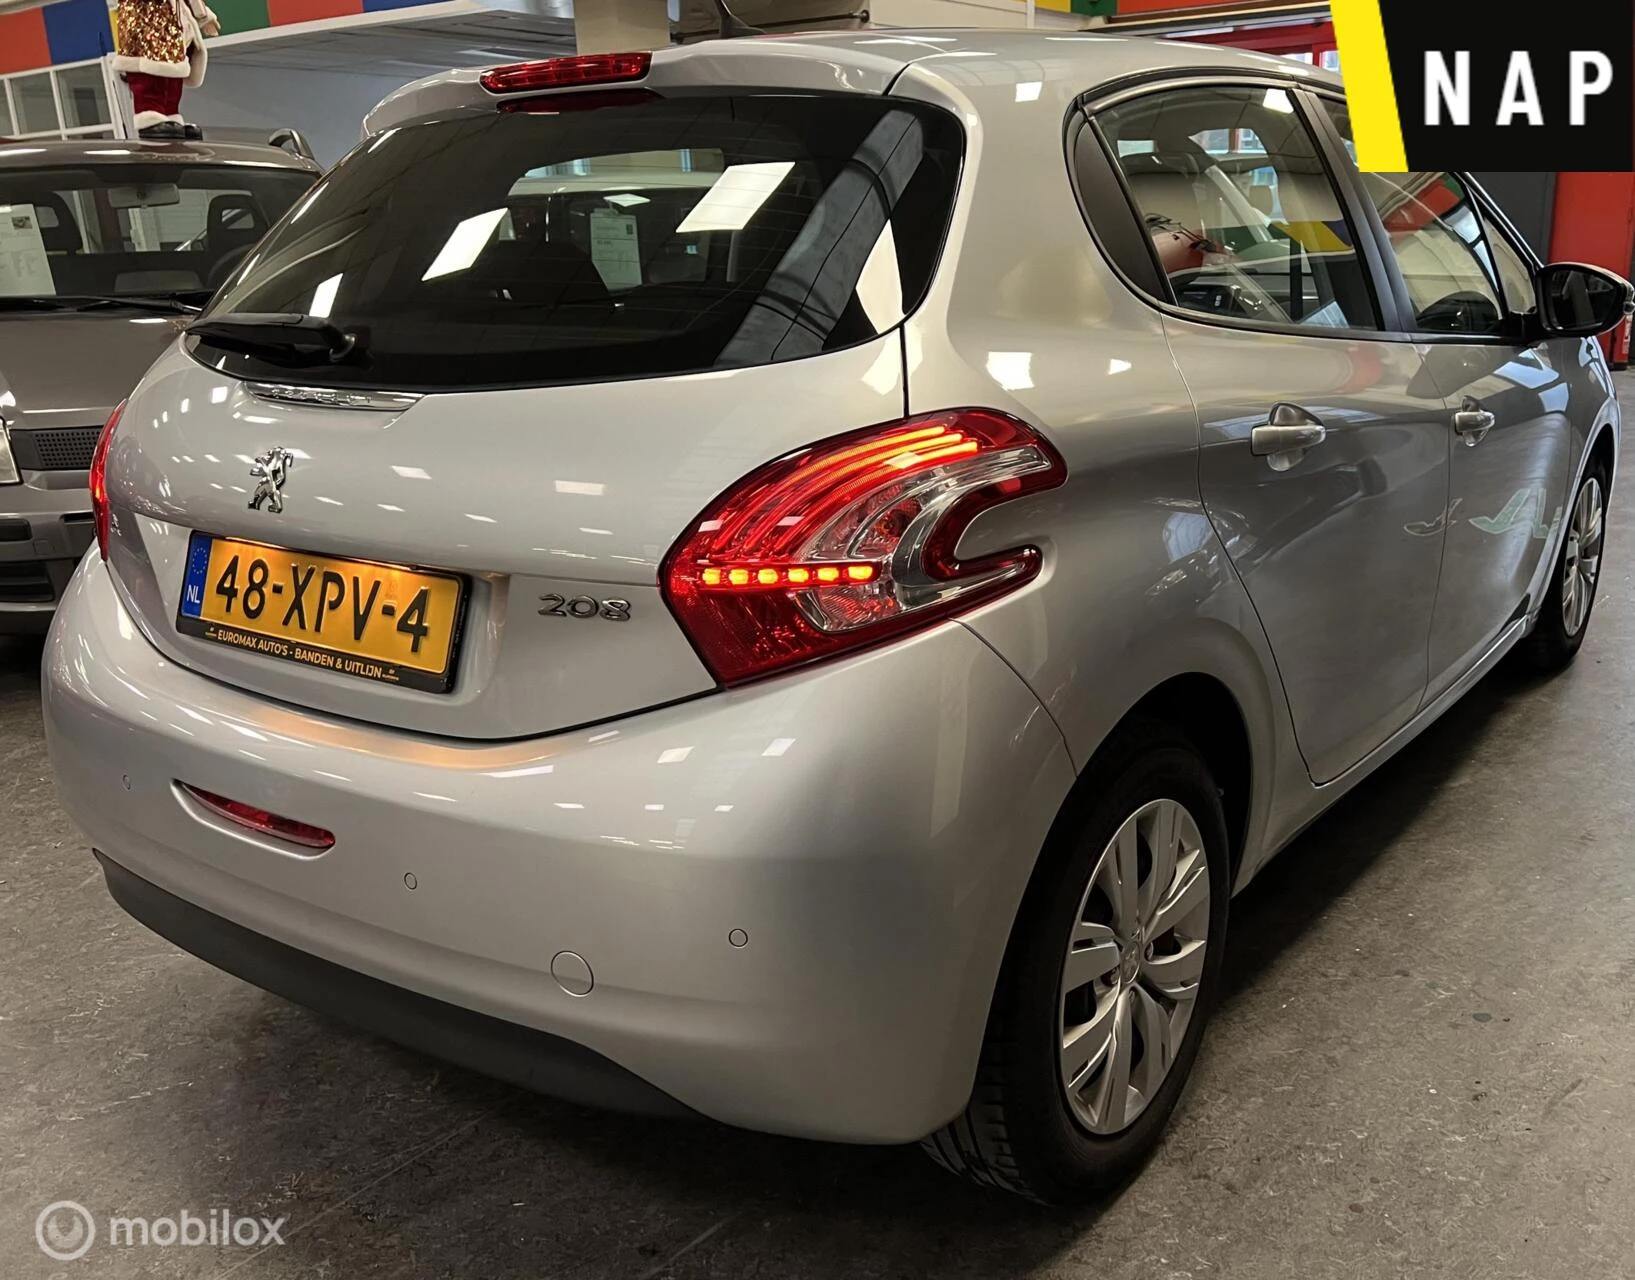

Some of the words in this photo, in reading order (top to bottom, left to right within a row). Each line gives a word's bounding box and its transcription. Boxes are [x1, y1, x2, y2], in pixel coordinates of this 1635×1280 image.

[186, 584, 201, 604] NL
[216, 554, 430, 653] 48-XPV-4
[537, 593, 631, 622] 208
[217, 629, 258, 649] EUROMAX
[257, 639, 288, 656] AUTO'S
[294, 648, 334, 667] BANDEN
[335, 657, 342, 669] &
[344, 660, 382, 678] UITLIJN
